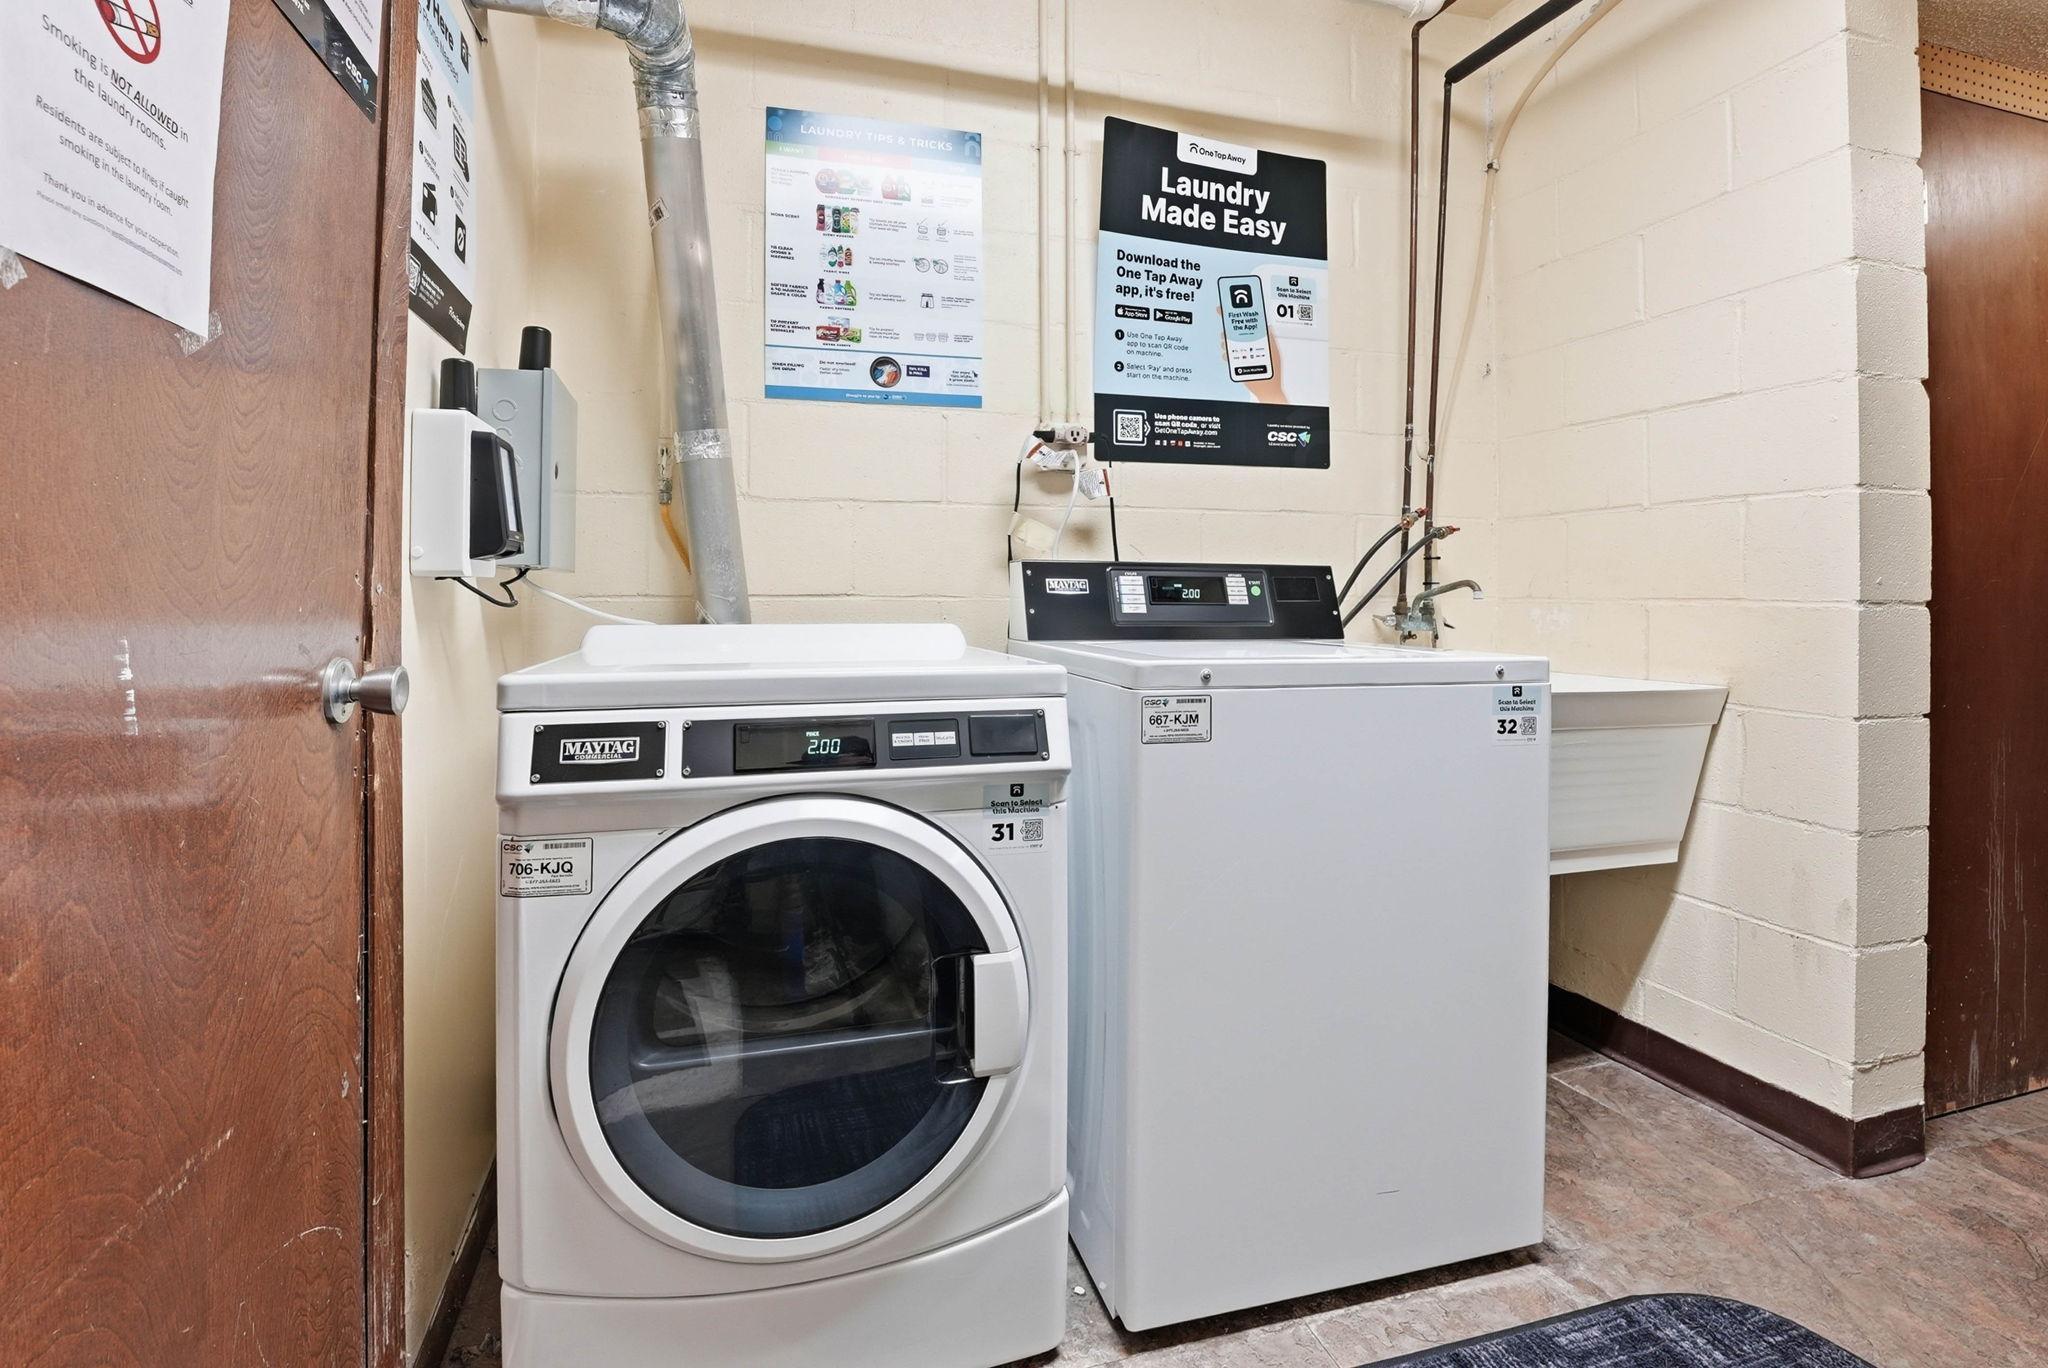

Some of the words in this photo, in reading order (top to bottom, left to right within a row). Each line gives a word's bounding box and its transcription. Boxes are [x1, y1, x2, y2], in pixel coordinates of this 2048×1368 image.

[433, 0, 454, 51] Here
[42, 14, 96, 70] Smoking
[101, 60, 108, 76] is
[111, 69, 132, 95] NOT
[134, 91, 178, 134] ALLOWED
[181, 127, 188, 142] in
[346, 57, 362, 83] CSC
[74, 68, 94, 93] the
[98, 83, 134, 126] laundry
[136, 119, 166, 150] rooms.
[800, 124, 861, 140] LAUNDRY
[866, 132, 893, 144] TIPS
[898, 135, 905, 144] &
[911, 137, 952, 151] TRICKS
[36, 95, 86, 136] Residents
[89, 132, 103, 147] are
[105, 142, 136, 168] subject
[133, 162, 145, 174] to
[142, 168, 158, 187] fines
[159, 182, 164, 191] if
[165, 187, 189, 208] caught
[1199, 147, 1214, 157] One
[1214, 150, 1226, 160] Tap
[1228, 154, 1246, 165] Away
[59, 135, 100, 168] smoking
[102, 159, 110, 173] in
[111, 167, 124, 182] the
[126, 175, 151, 204] laundry
[153, 195, 172, 216] room.
[1161, 166, 1270, 214] Laundry
[43, 172, 69, 194] Thank
[71, 188, 86, 203] you
[88, 195, 95, 206] in
[97, 202, 123, 223] advance
[125, 218, 133, 229] for
[1142, 194, 1216, 231] Made
[1224, 208, 1287, 245] Easy
[1117, 249, 1178, 268] Download
[1181, 259, 1200, 271] the
[1117, 266, 1141, 279] One
[1144, 270, 1166, 285] Tap
[1169, 273, 1203, 289] Away
[1116, 284, 1142, 298] app,
[1145, 285, 1163, 298] it's
[1166, 288, 1194, 302] free!
[1277, 304, 1294, 318] 01
[1154, 427, 1218, 436] GetOneTapAway.com
[1268, 431, 1297, 442] CSC
[1182, 589, 1200, 598] 2.00
[1149, 714, 1199, 725] 667-KJM
[1497, 719, 1517, 734] 32
[564, 741, 634, 755] MAYTAG
[808, 739, 840, 754] 2.00
[992, 823, 1014, 841] 31
[509, 861, 573, 875] 706-KJQ
